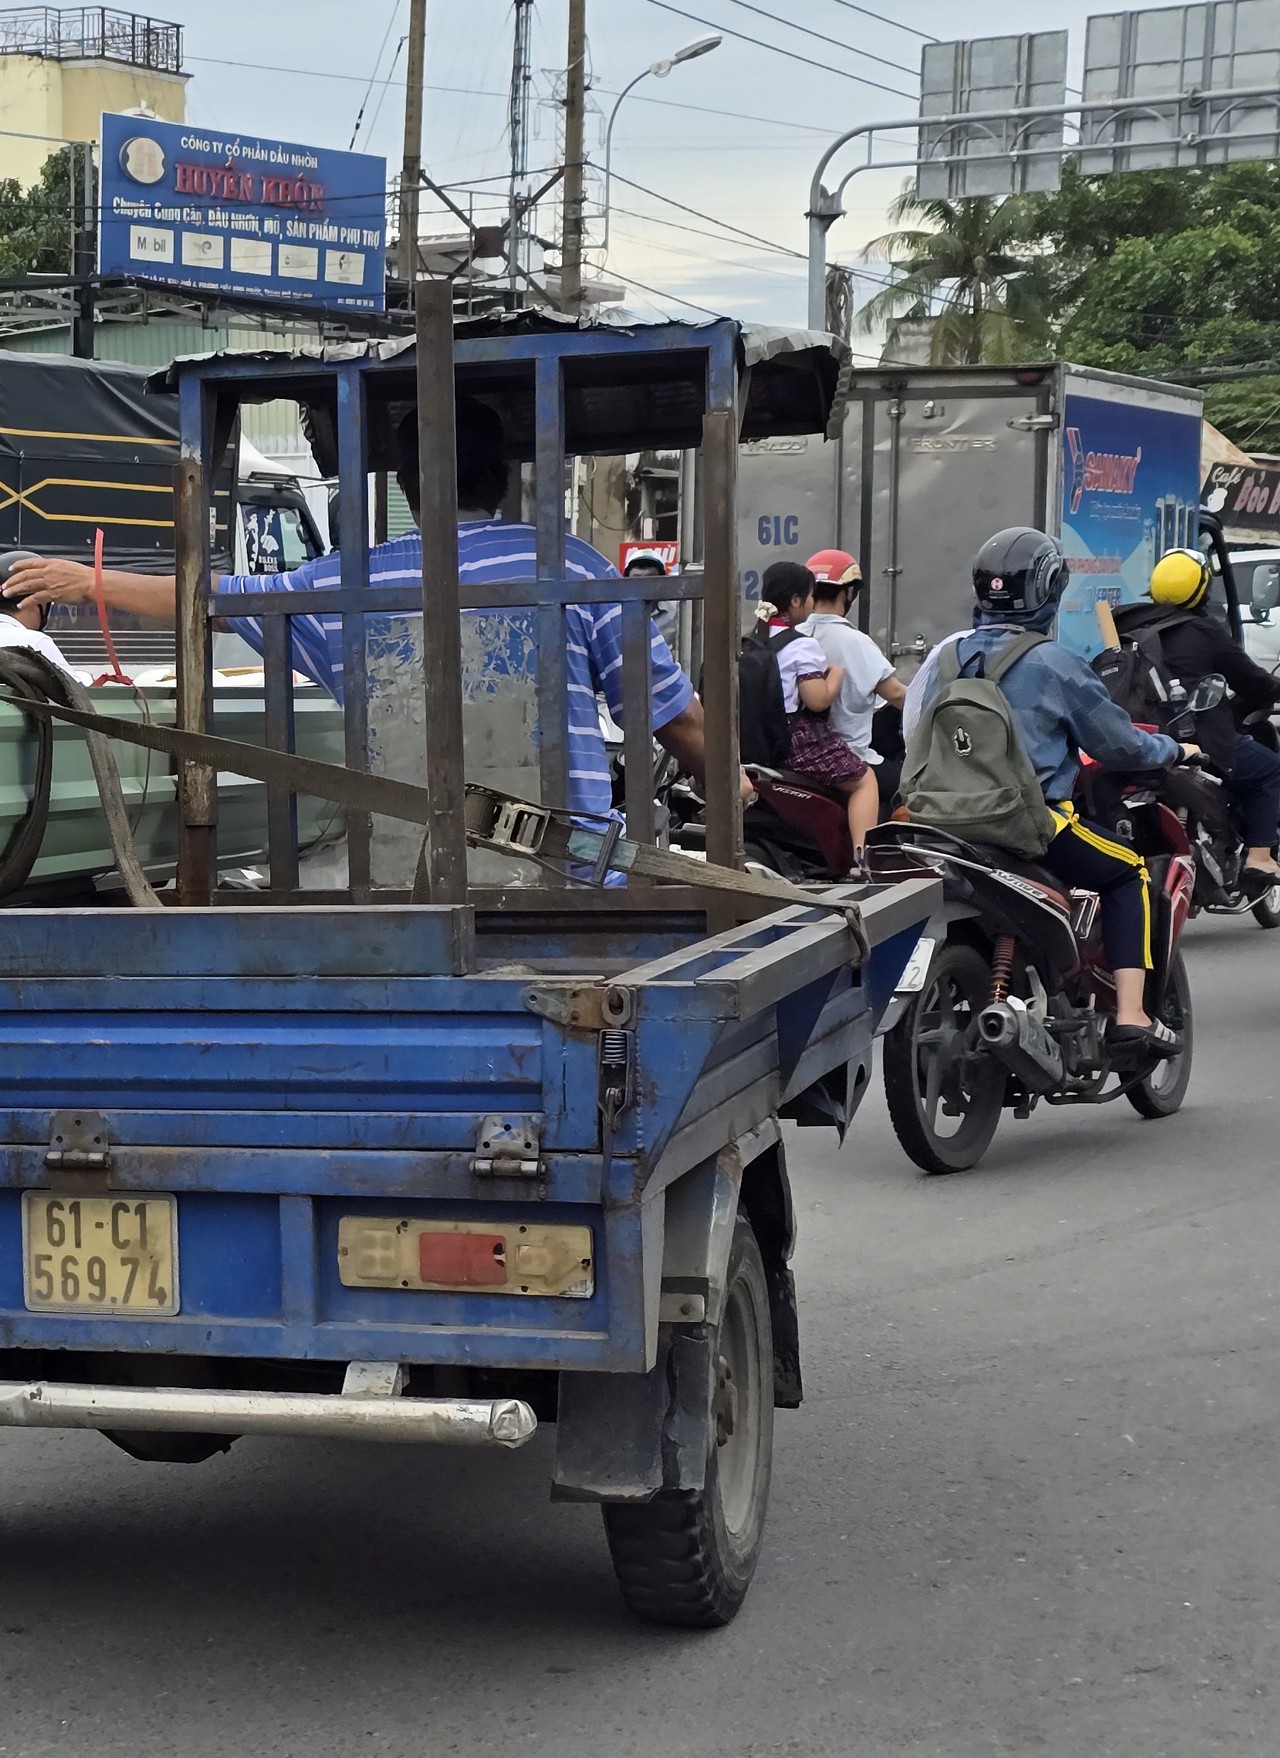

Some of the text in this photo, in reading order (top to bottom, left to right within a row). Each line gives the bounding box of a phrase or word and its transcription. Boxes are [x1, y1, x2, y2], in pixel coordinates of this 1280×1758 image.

[181, 135, 210, 152] CÔNG
[212, 141, 223, 153] TY
[137, 236, 166, 252] Mbil
[1212, 467, 1246, 488] Café
[757, 515, 799, 546] 61C
[46, 1200, 147, 1250] 61-C1
[34, 1254, 167, 1305] 569.74
